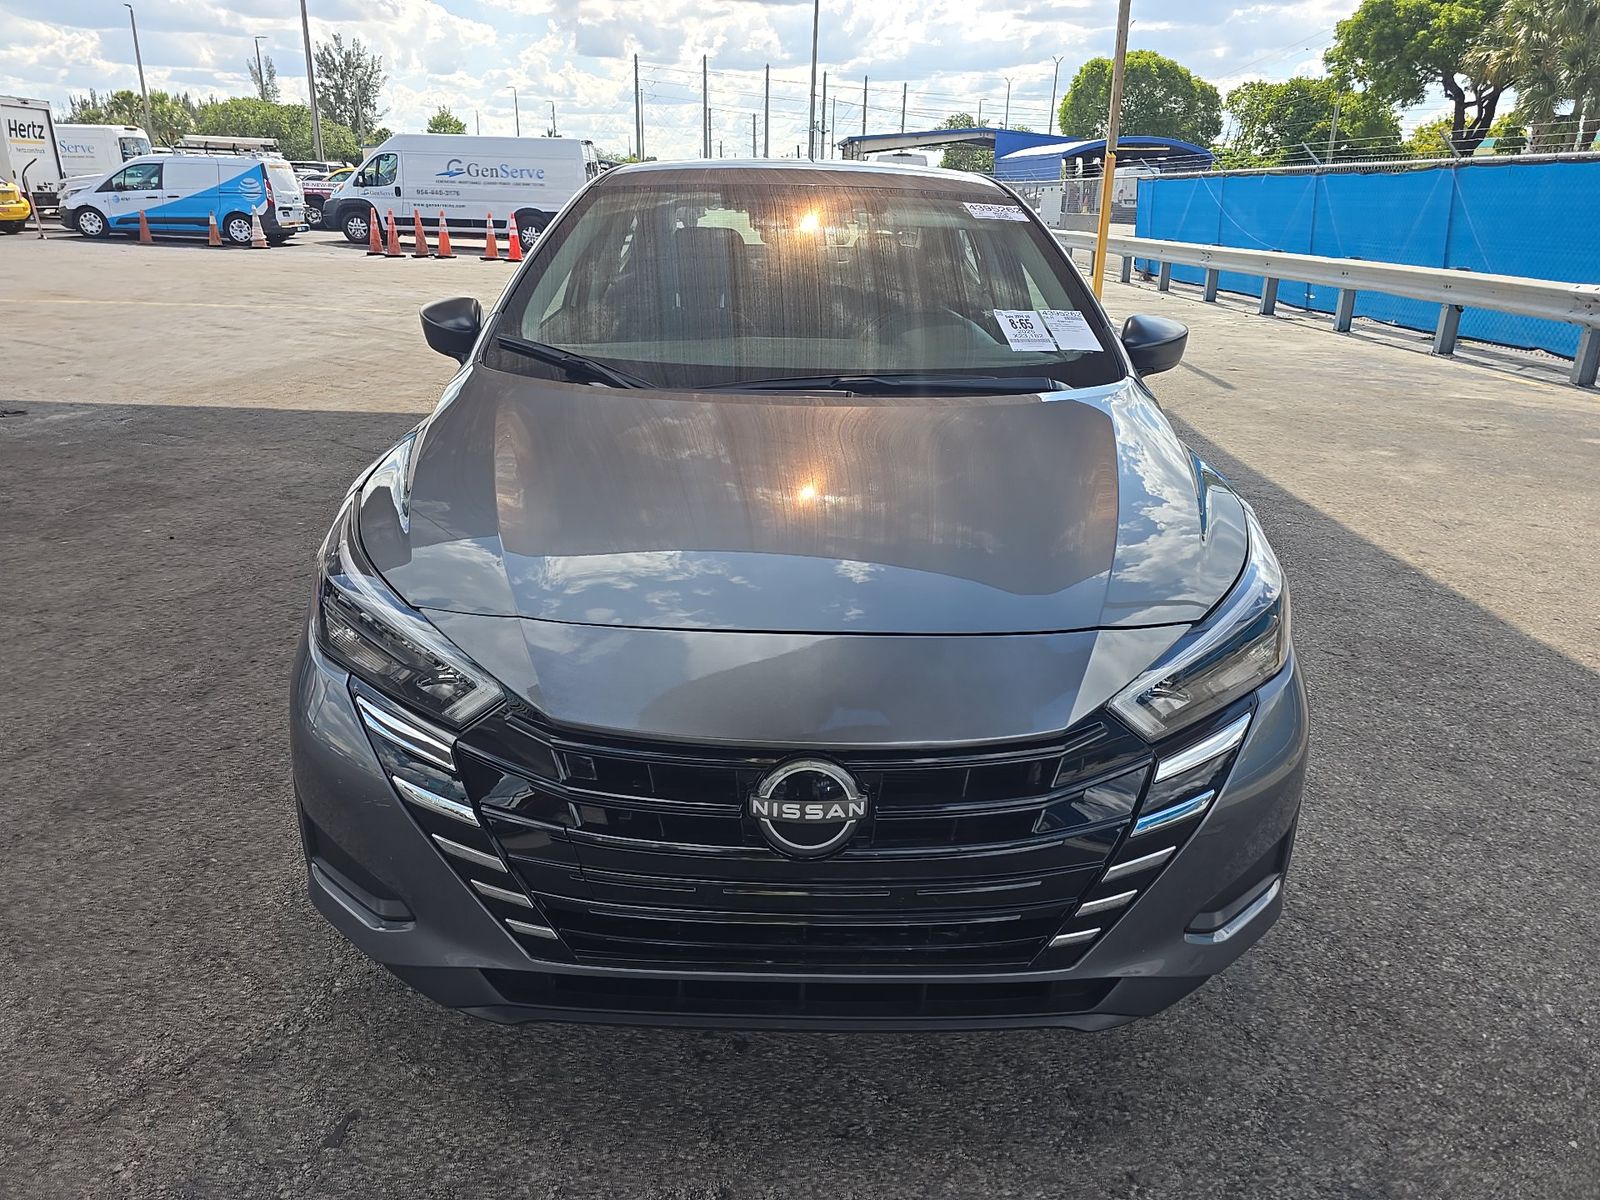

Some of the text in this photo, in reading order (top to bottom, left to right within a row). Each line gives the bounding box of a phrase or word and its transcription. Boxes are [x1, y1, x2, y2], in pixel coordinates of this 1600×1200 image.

[8, 119, 45, 139] Hertz
[466, 162, 545, 179] GenServe
[1008, 318, 1034, 330] 8:65
[752, 799, 865, 820] NISSAN
